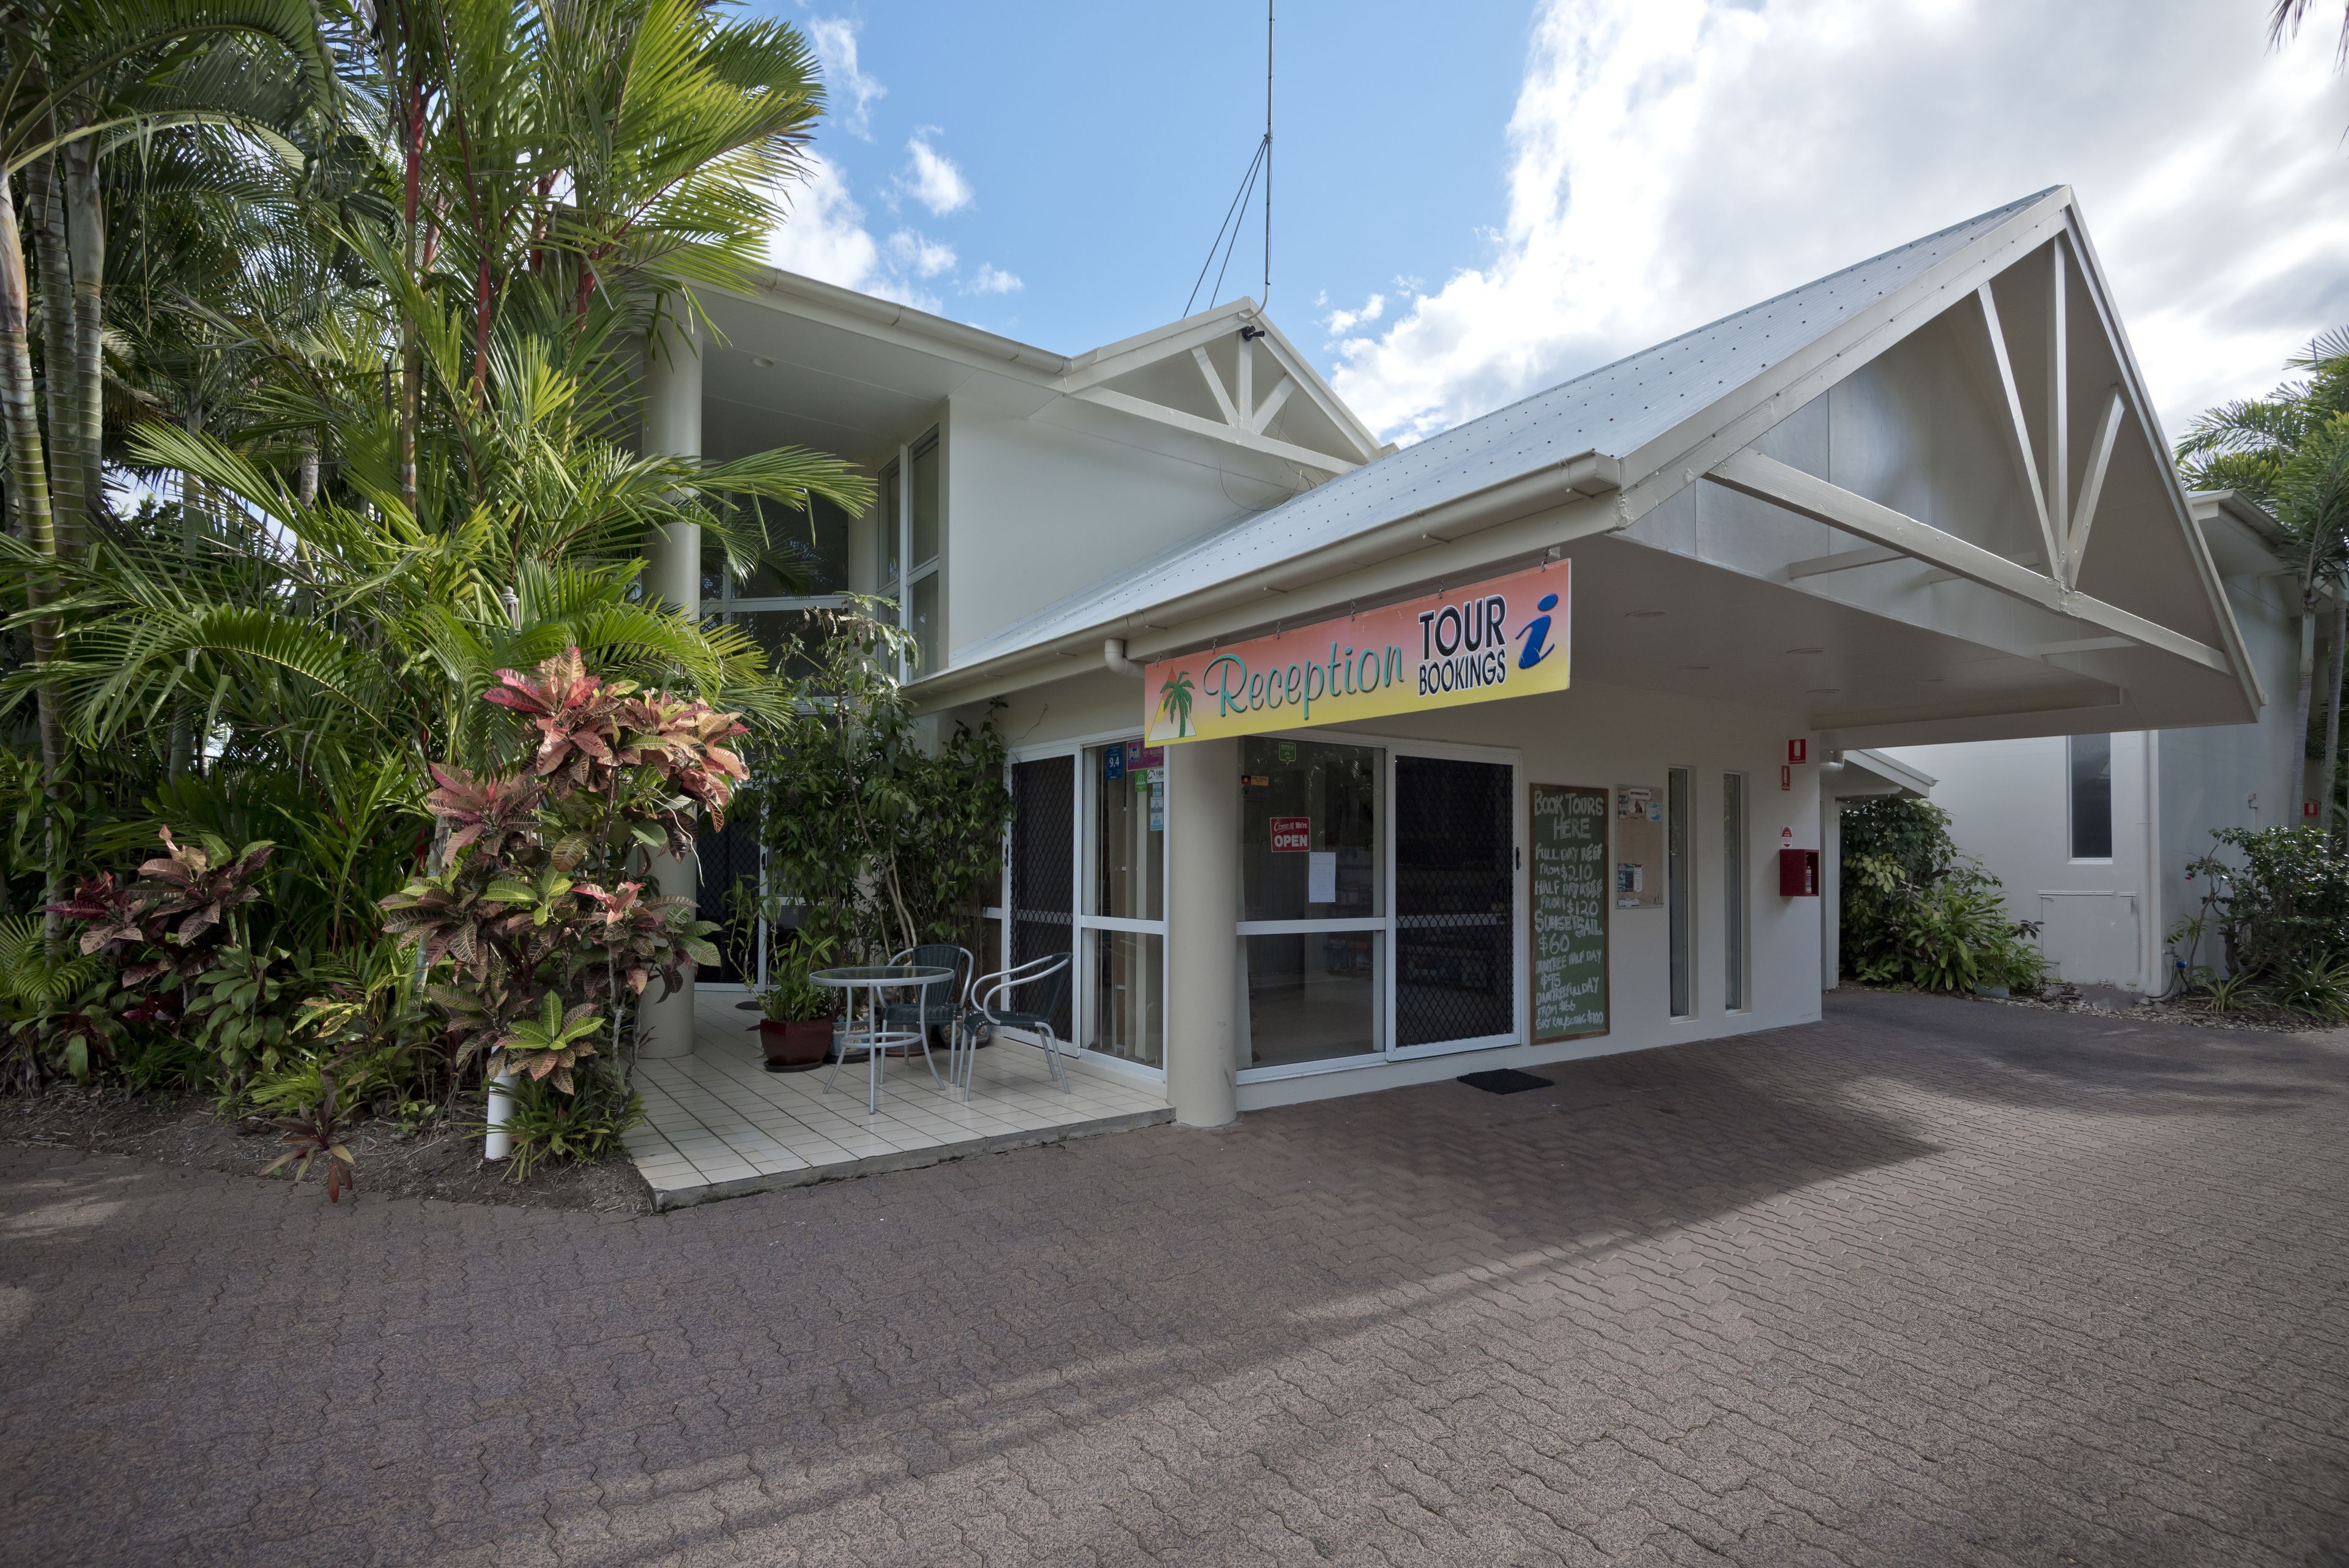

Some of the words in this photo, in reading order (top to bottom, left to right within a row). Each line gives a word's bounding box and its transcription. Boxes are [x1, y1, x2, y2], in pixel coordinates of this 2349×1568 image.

[1419, 594, 1507, 660] TOUR
[1203, 641, 1405, 720] Reception
[1419, 648, 1507, 697] BOOKINGS
[1110, 756, 1119, 768] 9.4
[1274, 822, 1289, 831] Come
[1554, 817, 1591, 840] HERE
[1274, 834, 1308, 848] OPEN
[1535, 842, 1560, 860] FULL
[1560, 847, 1578, 863] DAY
[1581, 843, 1603, 861] REEF
[1540, 863, 1560, 875] FROM
[1535, 879, 1560, 895] HALF
[1563, 882, 1579, 898] DAY
[1579, 879, 1603, 898] REEF
[1540, 895, 1566, 910] FROM
[1567, 899, 1599, 918] $120
[1538, 933, 1570, 957] $60
[1568, 950, 1584, 965] HALF
[1586, 949, 1601, 964] DAY
[1540, 972, 1561, 991] $95
[1582, 976, 1600, 994] DAY
[1536, 1017, 1551, 1030] SKY
